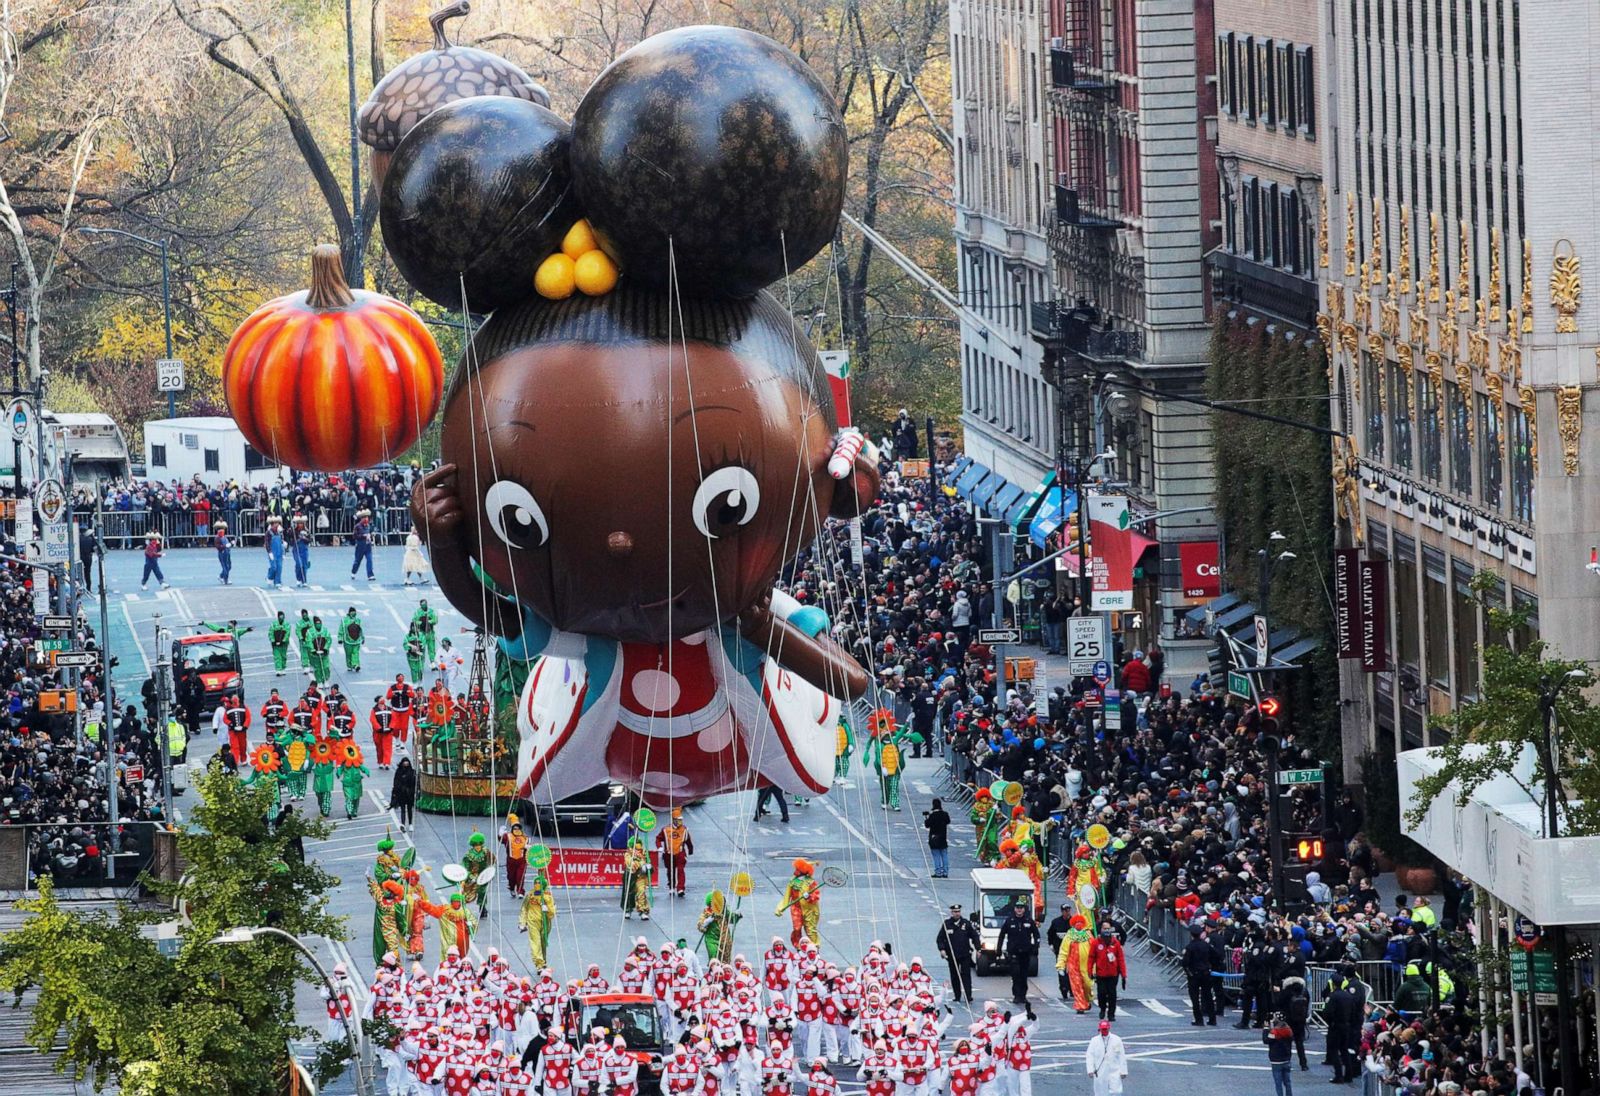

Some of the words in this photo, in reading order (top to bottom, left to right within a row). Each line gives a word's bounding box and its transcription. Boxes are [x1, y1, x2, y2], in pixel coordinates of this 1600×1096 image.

[162, 376, 181, 388] 20
[50, 525, 66, 534] NYP
[1338, 554, 1348, 604] QUALITY
[1363, 568, 1374, 617] QUALITY
[1340, 607, 1350, 652] ITALIAN
[44, 641, 50, 649] W
[53, 640, 62, 649] 58
[1074, 642, 1100, 658] 25
[1364, 621, 1374, 666] ITALIAN
[1289, 772, 1296, 782] W
[1301, 772, 1312, 782] 57
[1314, 840, 1322, 856] 0
[556, 863, 599, 874] JIMMIE
[604, 864, 624, 874] ALL
